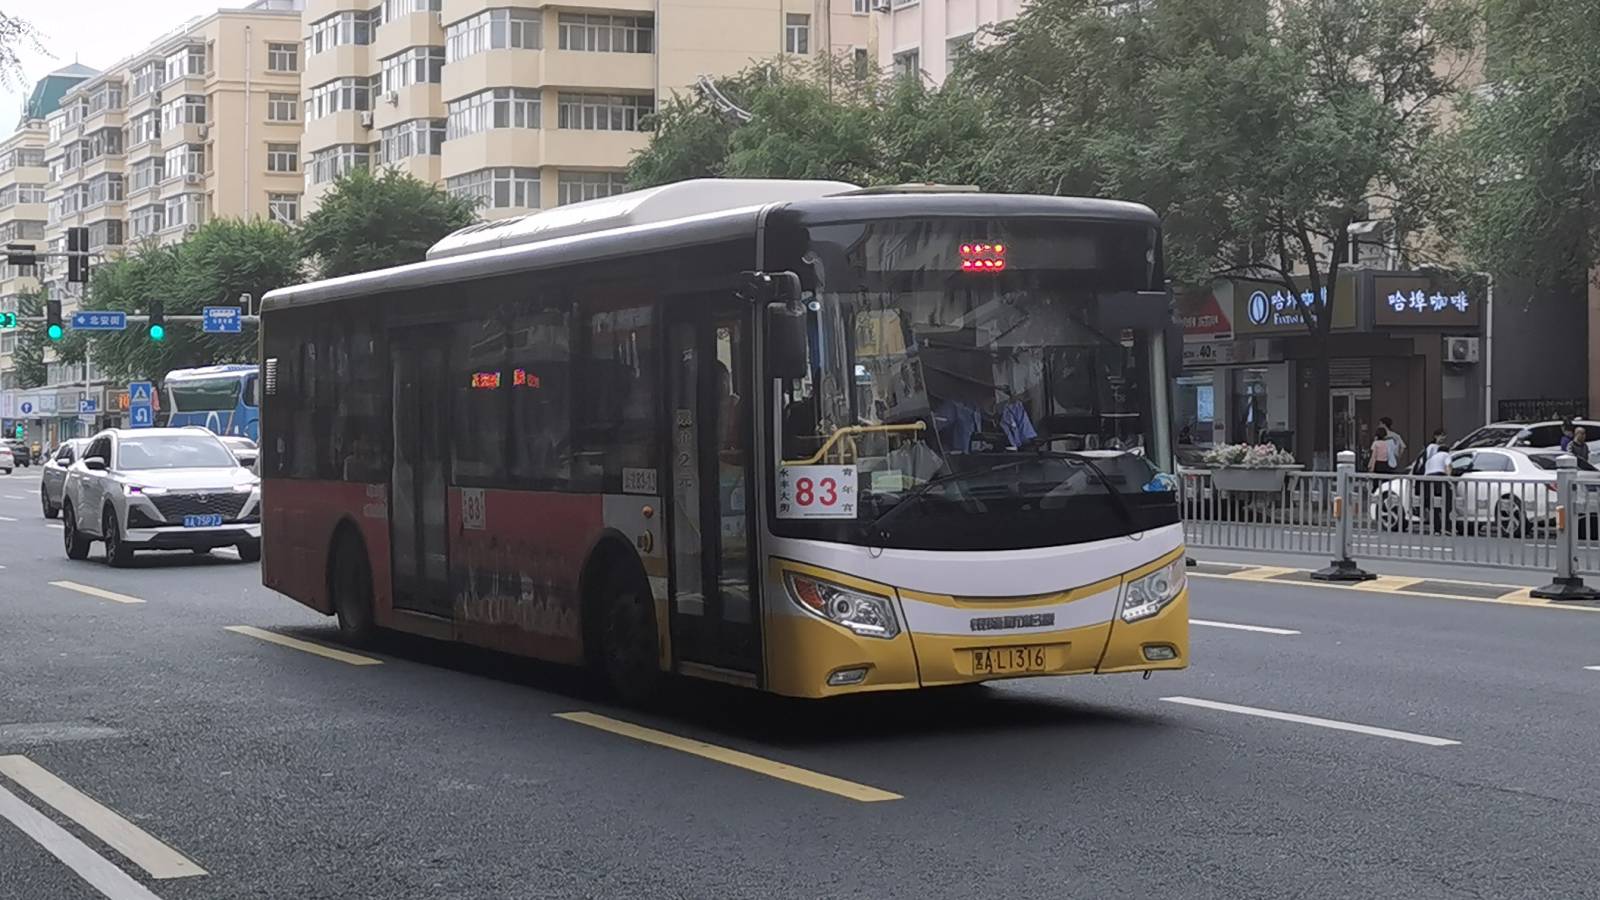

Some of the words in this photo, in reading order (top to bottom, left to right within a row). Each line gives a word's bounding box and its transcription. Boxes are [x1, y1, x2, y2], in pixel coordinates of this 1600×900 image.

[1388, 290, 1469, 312] 哈埠咖啡
[796, 477, 837, 506] 83
